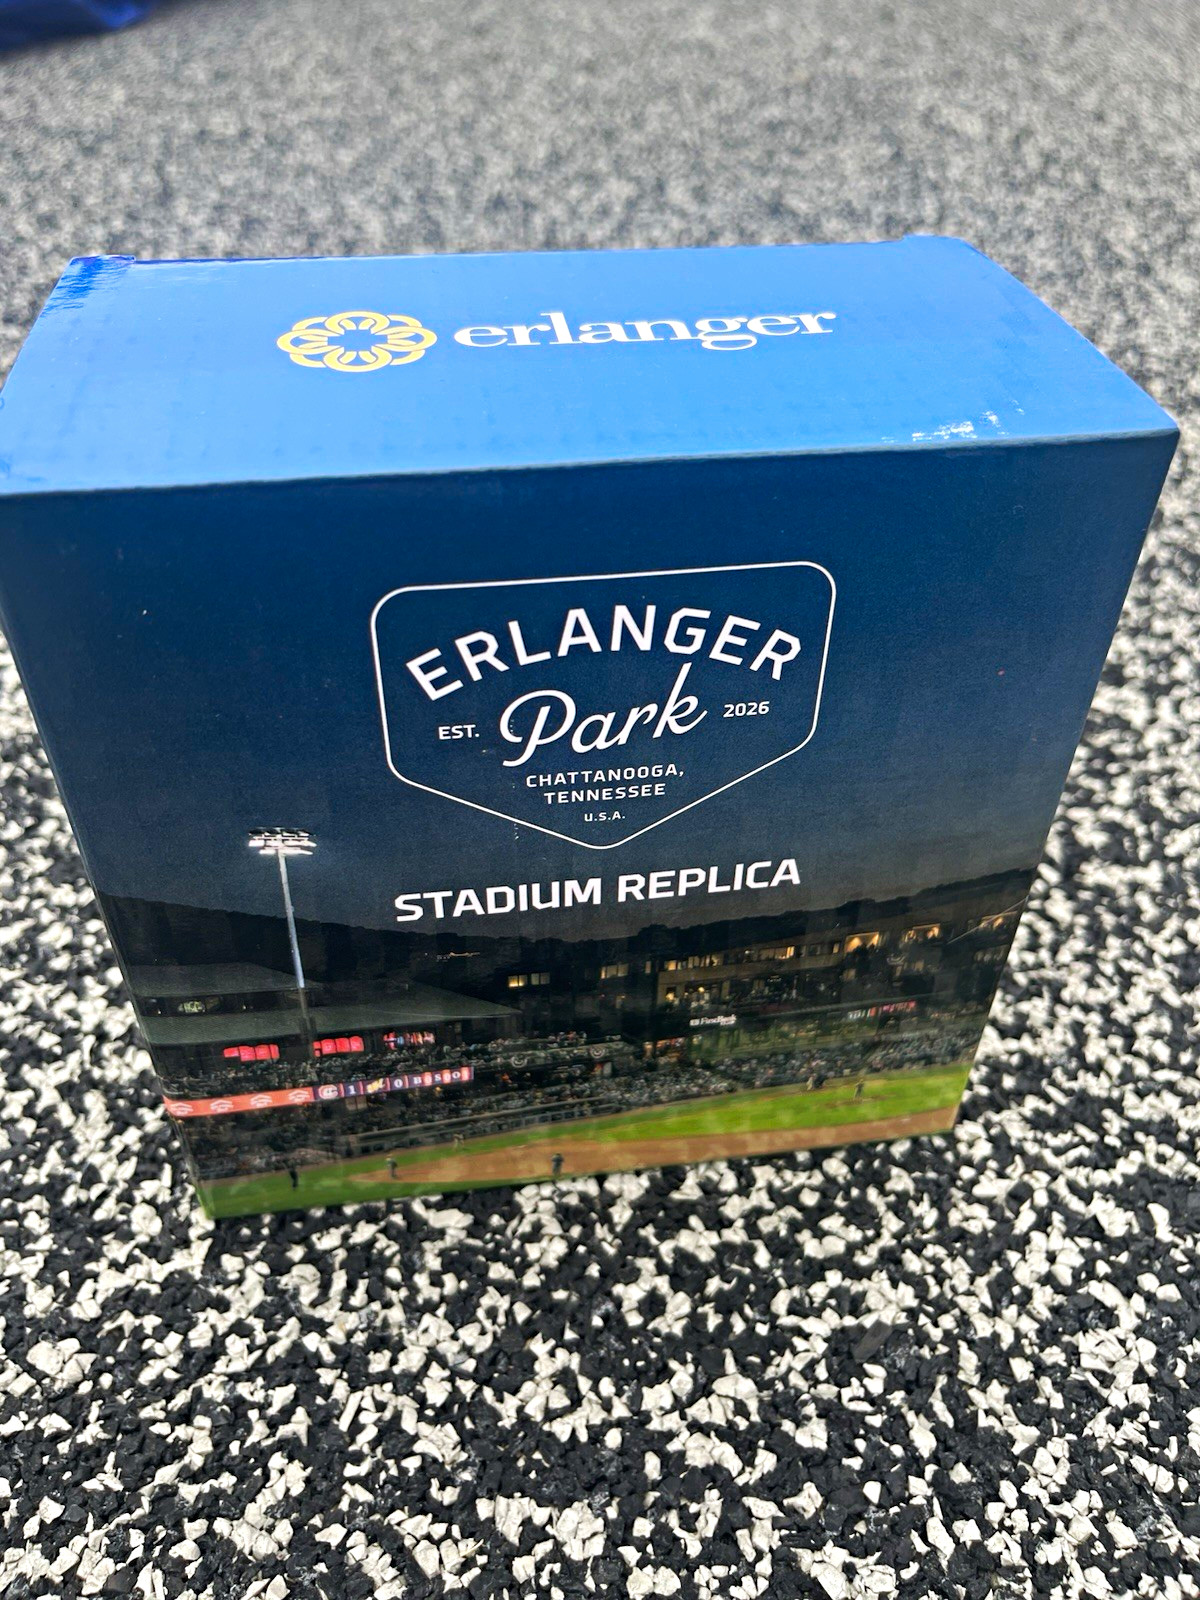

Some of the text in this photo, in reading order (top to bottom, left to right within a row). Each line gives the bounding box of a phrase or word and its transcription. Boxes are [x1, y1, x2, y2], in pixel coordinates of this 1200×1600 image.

[453, 311, 837, 351] erlanger
[405, 604, 802, 701] ERLANGER
[499, 661, 708, 767] Park
[723, 700, 770, 718] 2026
[438, 724, 480, 741] EST.
[525, 763, 684, 788] CHATTANOOGA,
[543, 783, 666, 805] TENNESSEE
[583, 810, 626, 822] U.S.A.
[394, 858, 801, 922] STADIUM REPLICA
